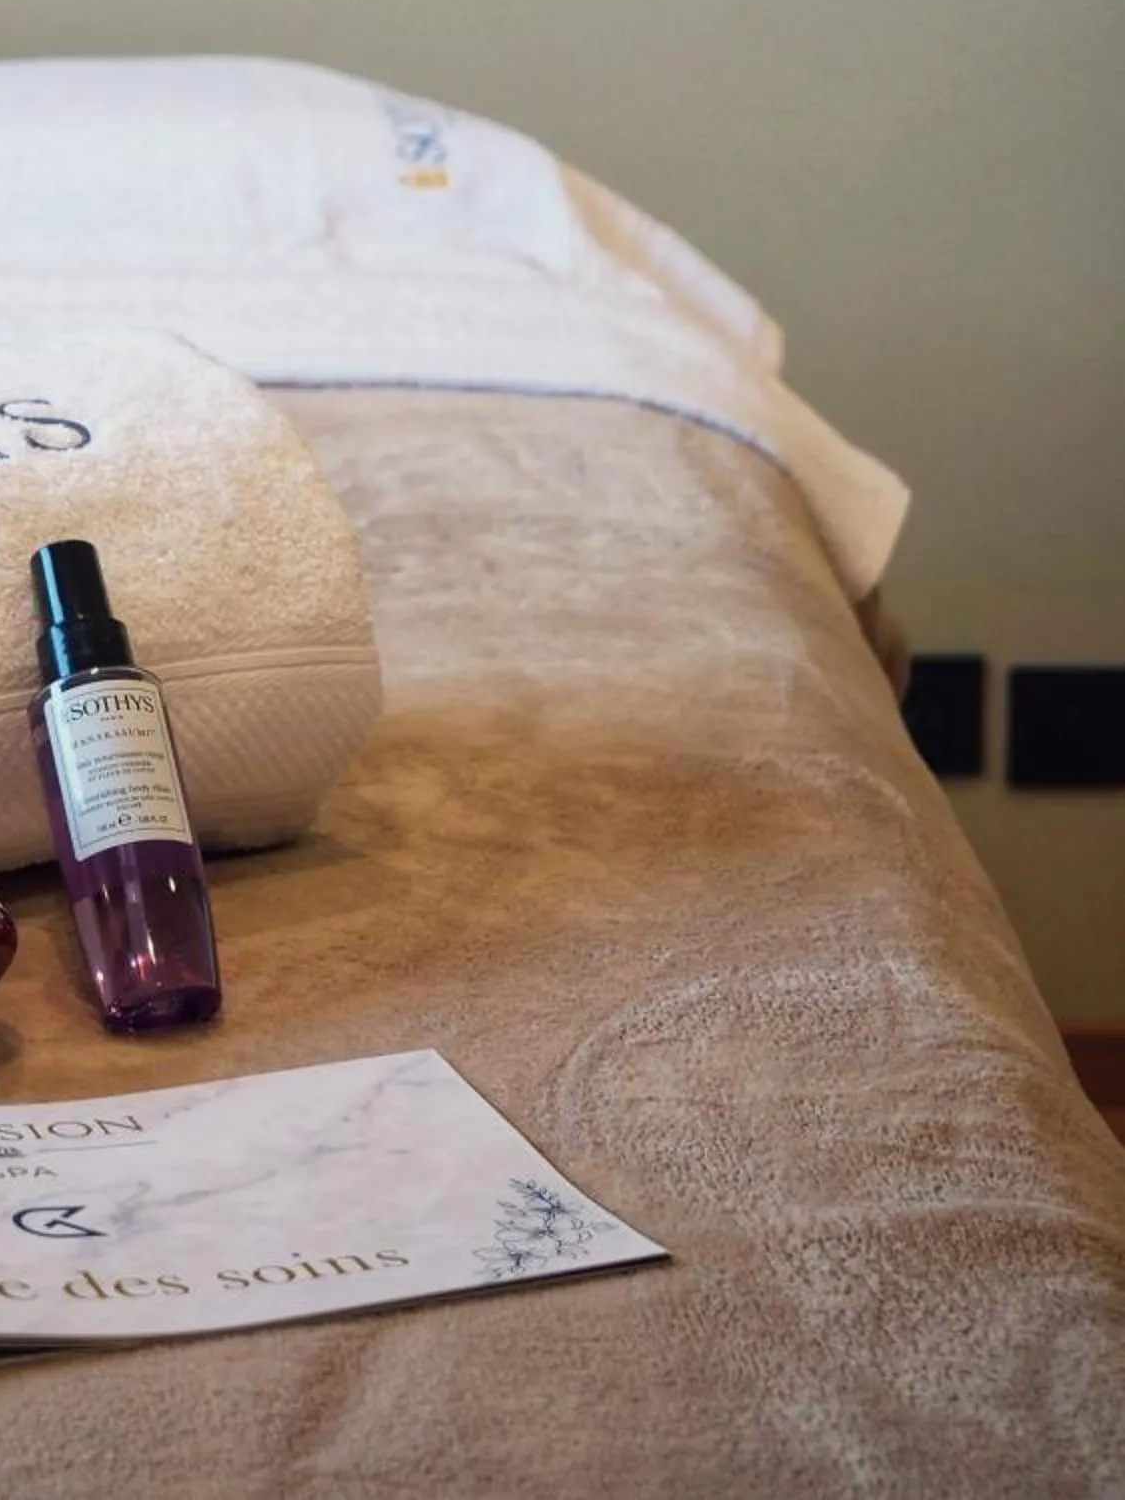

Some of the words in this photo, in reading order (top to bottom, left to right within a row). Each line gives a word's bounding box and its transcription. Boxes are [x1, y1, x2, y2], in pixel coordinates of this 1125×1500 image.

[70, 693, 155, 722] SOTHYS
[62, 1268, 189, 1301] des
[217, 1245, 410, 1293] soins
